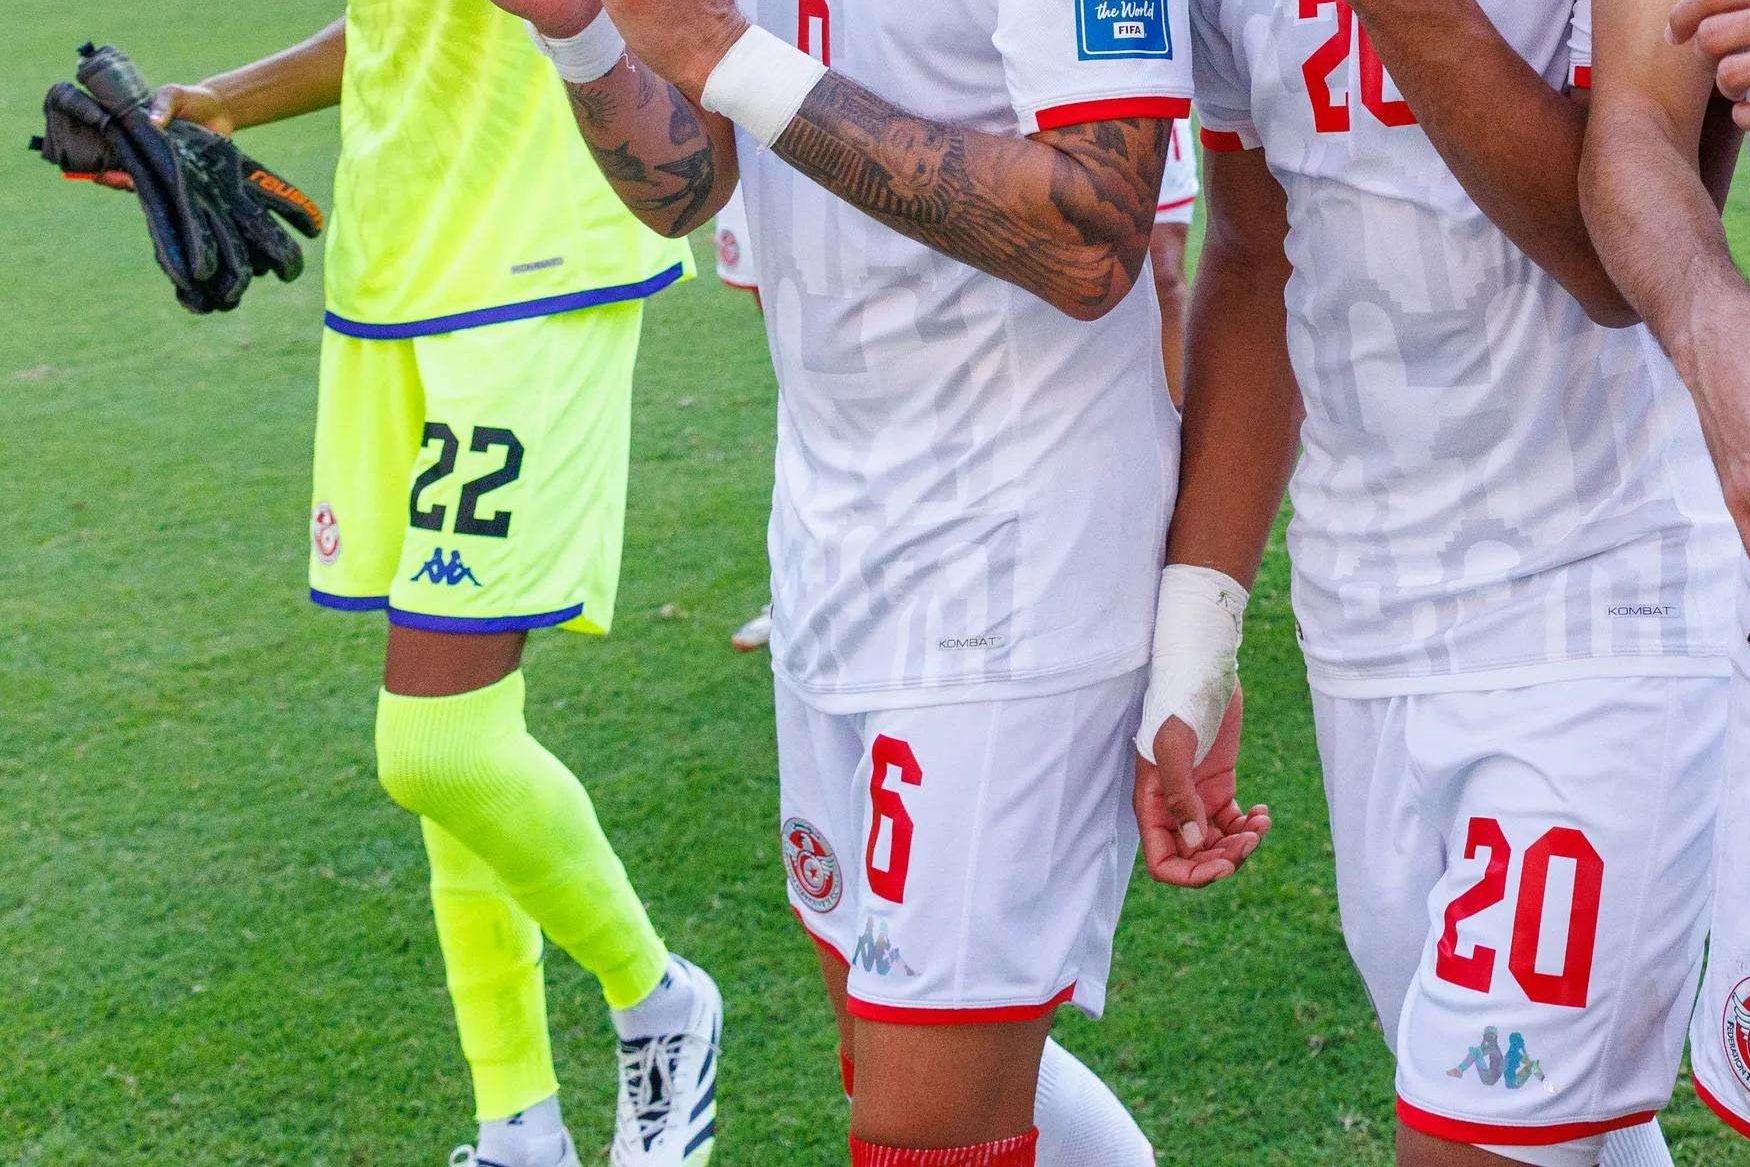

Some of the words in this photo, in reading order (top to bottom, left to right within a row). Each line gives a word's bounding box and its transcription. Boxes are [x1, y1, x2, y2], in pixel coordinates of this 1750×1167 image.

[1095, 1, 1120, 20] the
[1120, 0, 1154, 21] World
[1118, 25, 1141, 35] FIFA
[409, 421, 525, 539] 22
[1608, 606, 1675, 616] KOMBAT
[939, 637, 999, 648] KOMBAT
[865, 733, 923, 904] 6
[1436, 817, 1605, 1008] 20
[1727, 1020, 1746, 1077] FEDERATION
